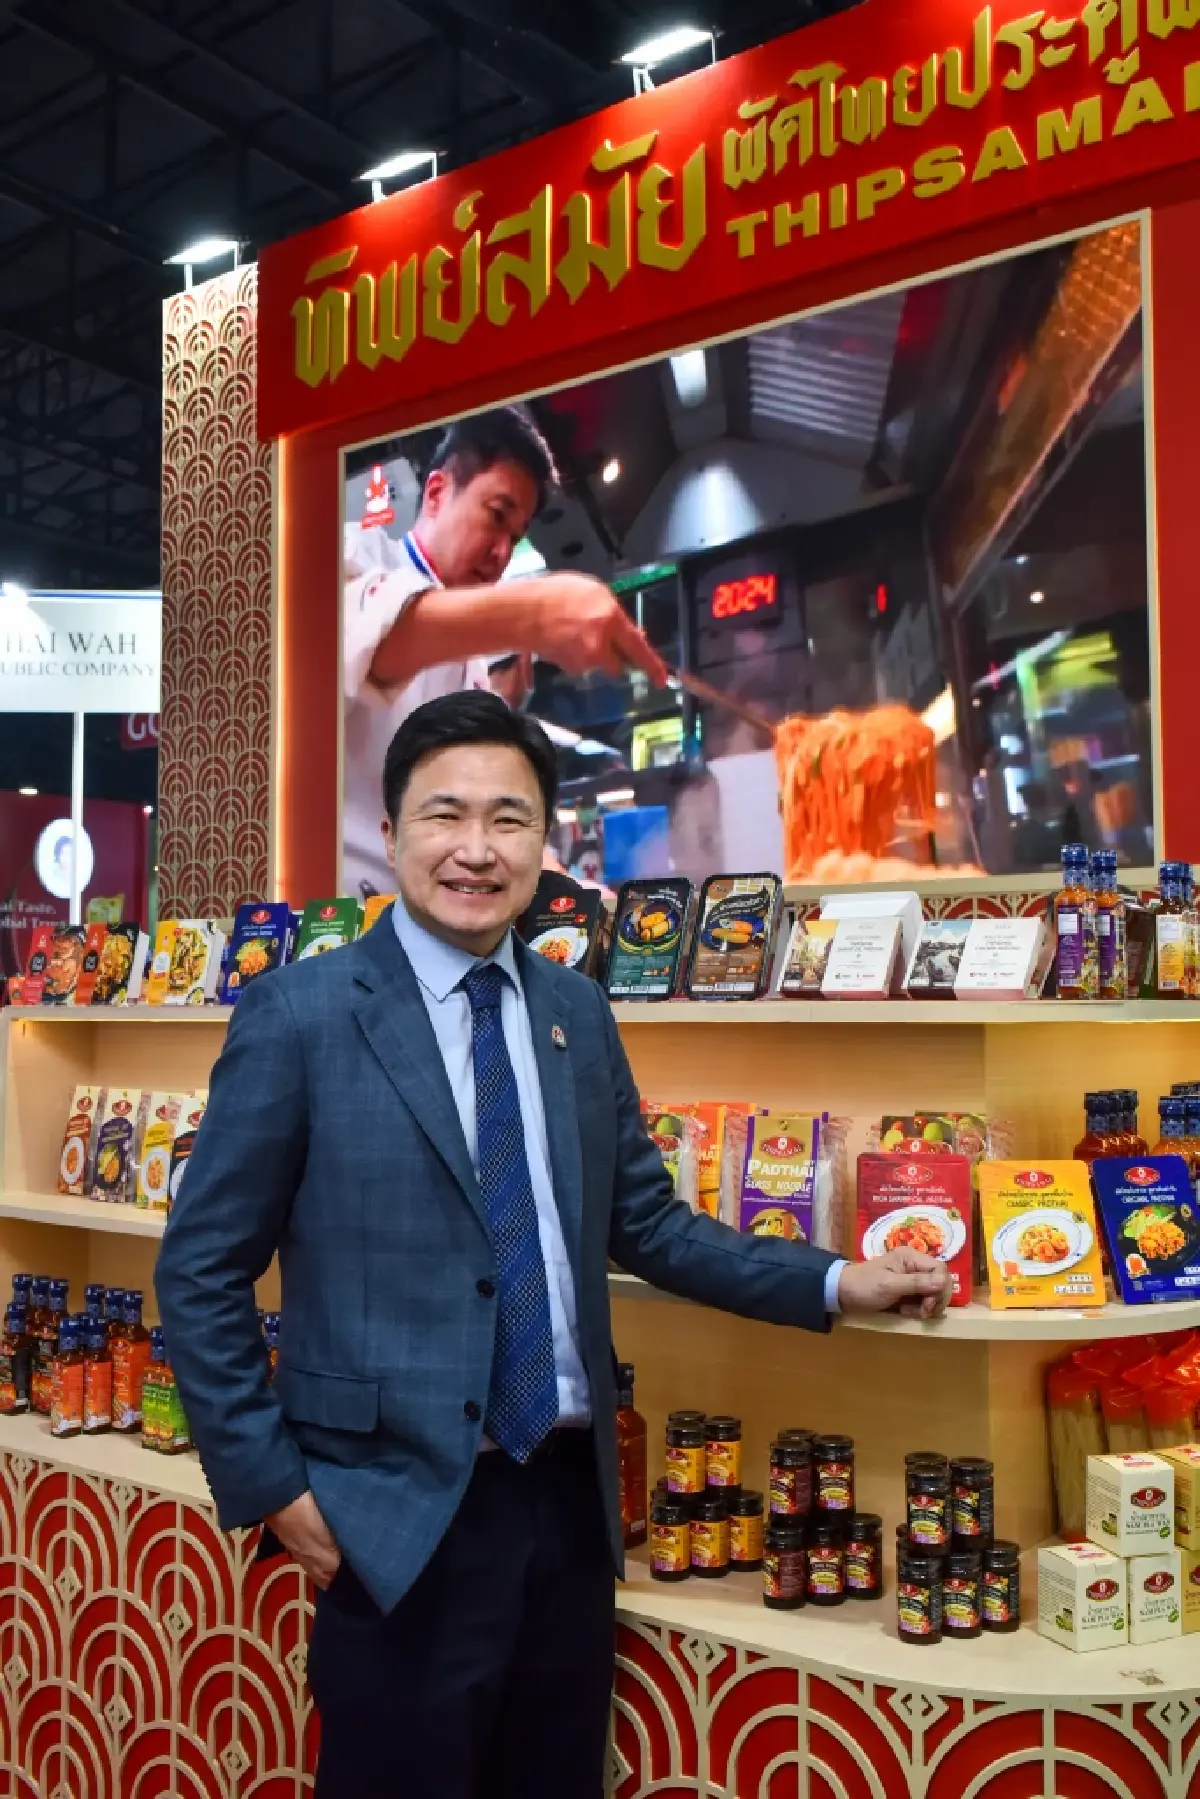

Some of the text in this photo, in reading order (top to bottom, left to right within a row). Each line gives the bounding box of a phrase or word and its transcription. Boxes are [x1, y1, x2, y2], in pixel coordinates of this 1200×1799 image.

[290, 130, 706, 388] ทิพย์สมัย
[712, 573, 777, 618] 2024
[68, 631, 136, 654] WAH
[62, 661, 154, 676] COMPANY
